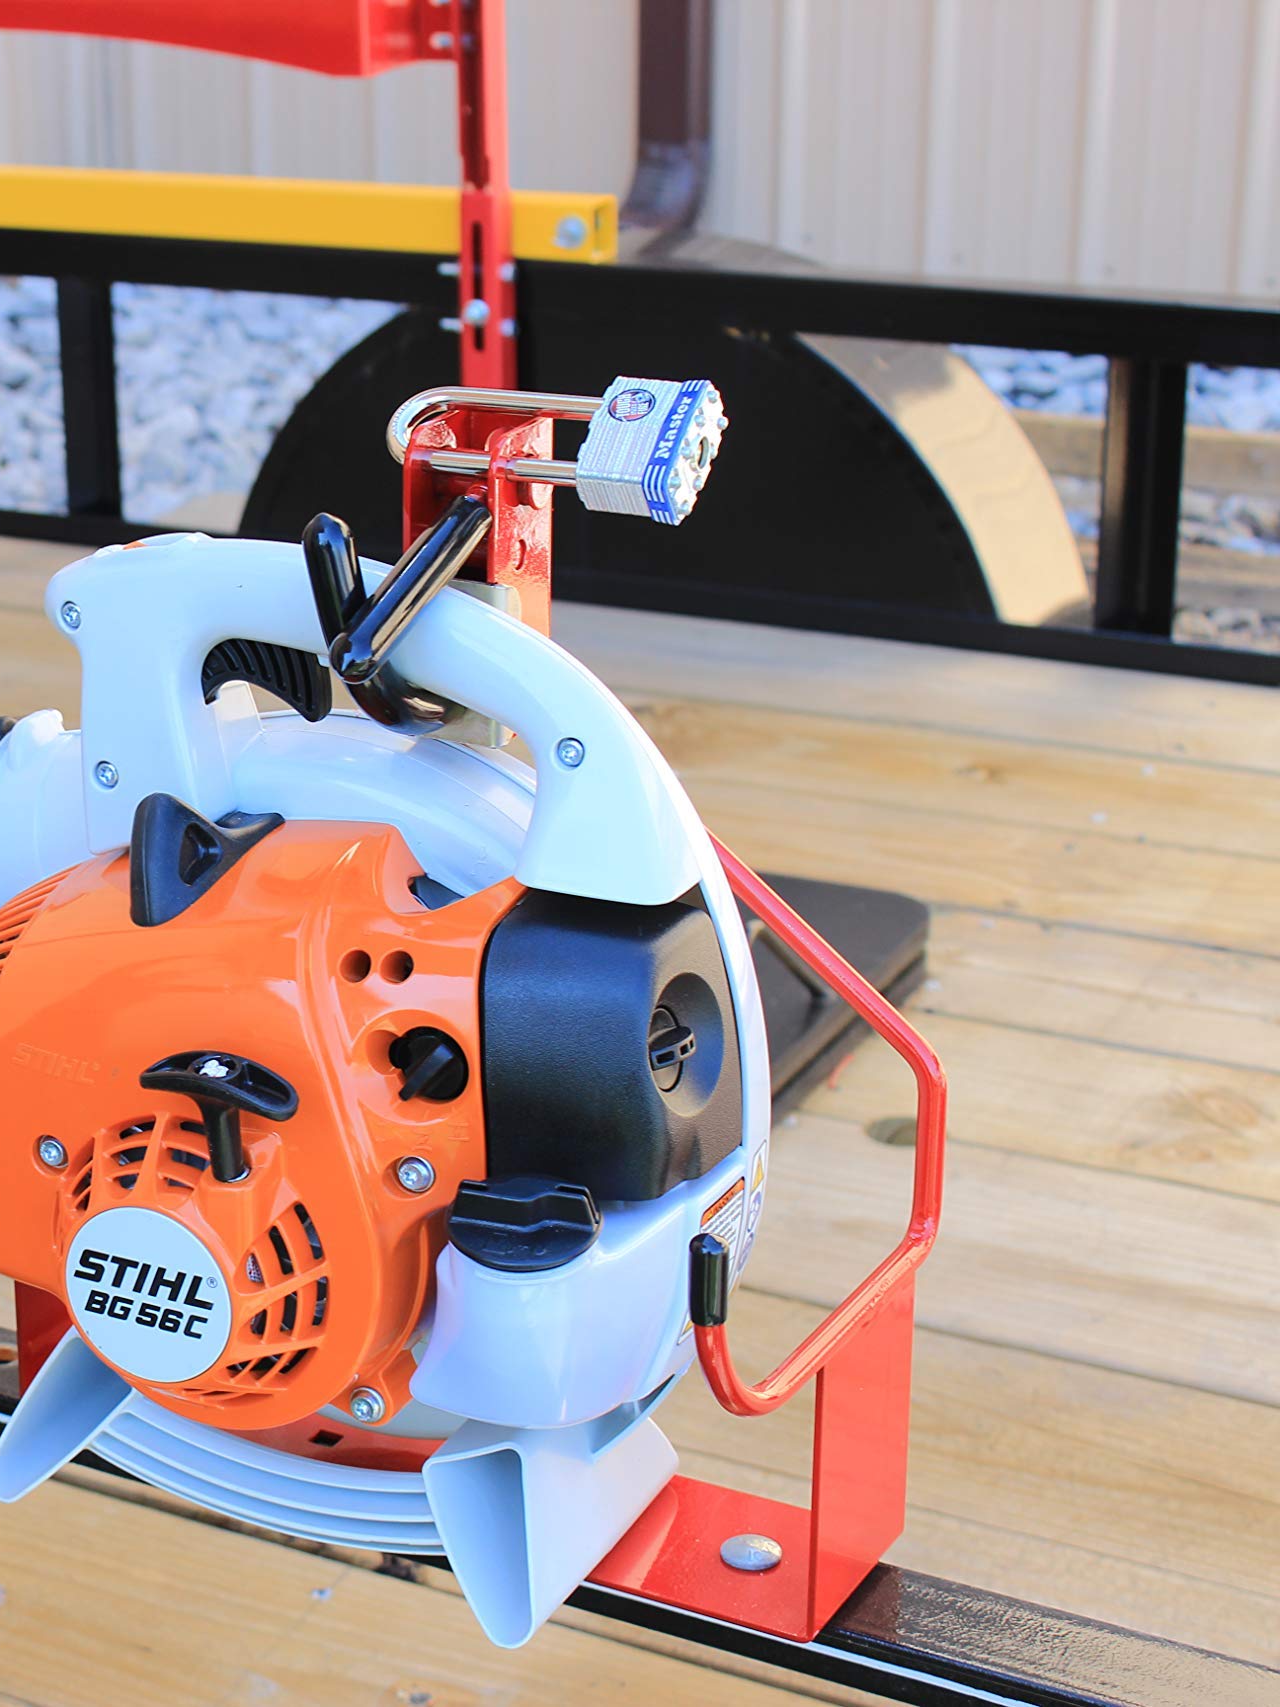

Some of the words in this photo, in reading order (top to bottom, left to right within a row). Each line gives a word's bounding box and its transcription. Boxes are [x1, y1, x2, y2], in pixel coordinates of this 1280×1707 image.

[654, 396, 694, 460] Master
[73, 1248, 215, 1311] STIHL
[84, 1289, 135, 1321] BG
